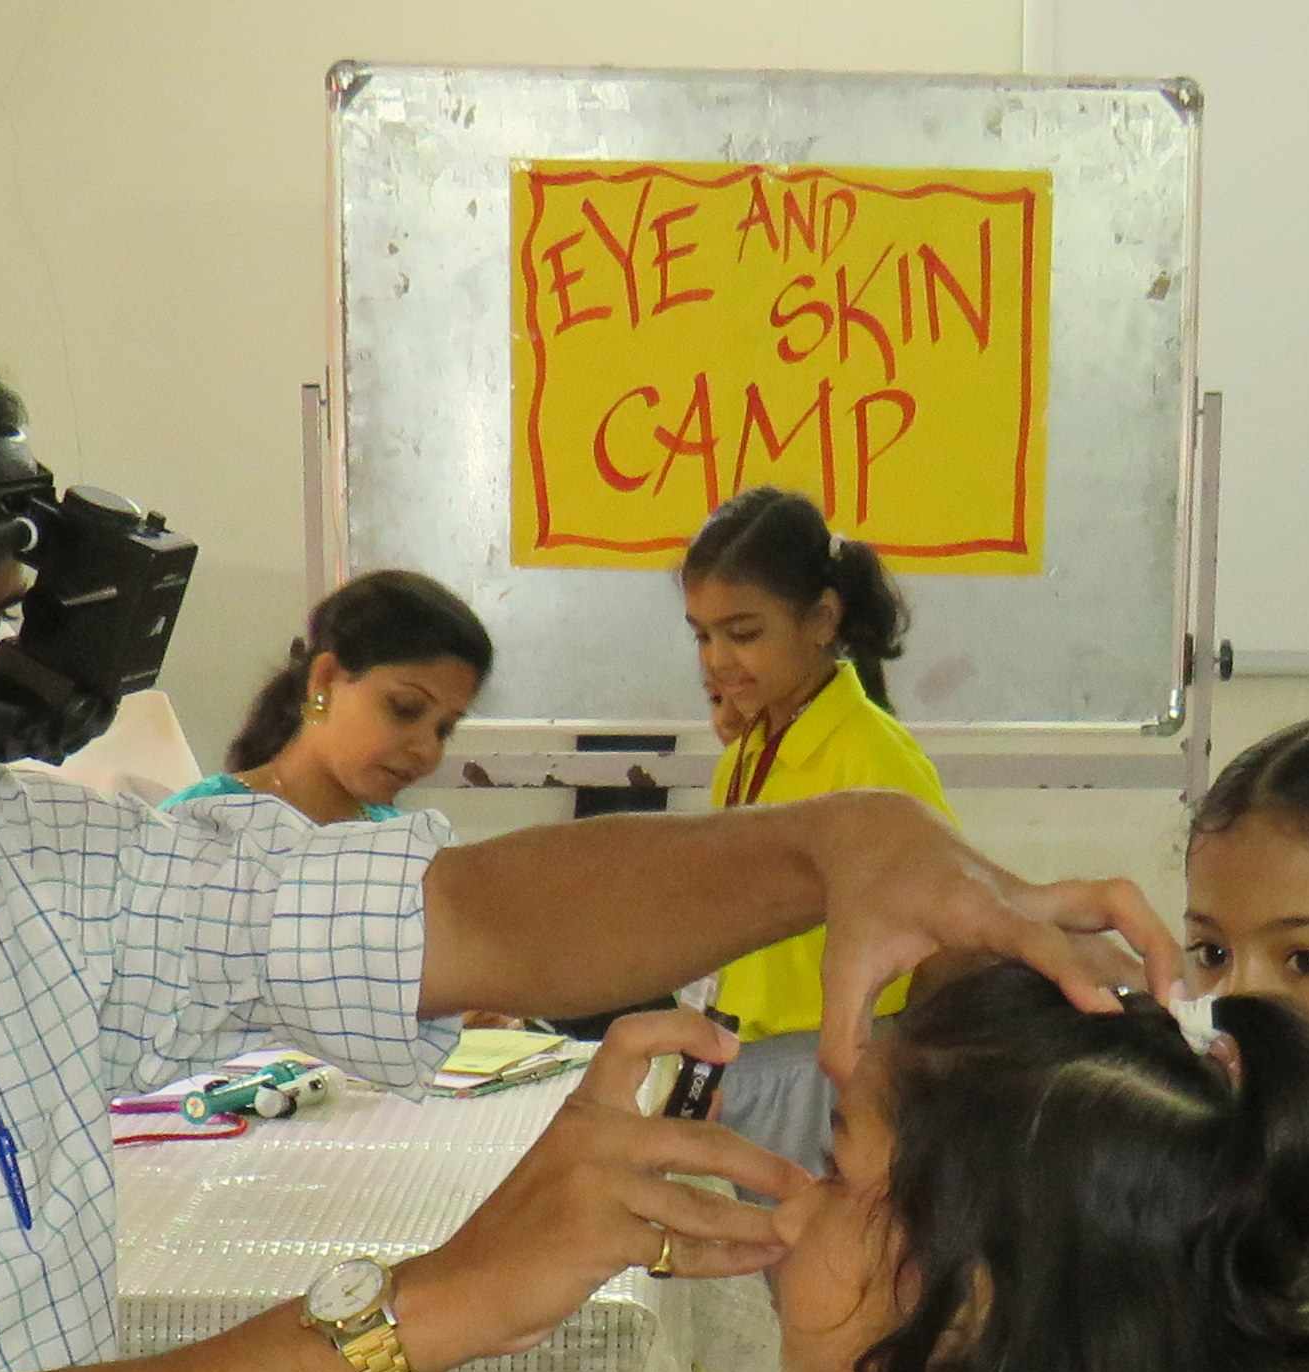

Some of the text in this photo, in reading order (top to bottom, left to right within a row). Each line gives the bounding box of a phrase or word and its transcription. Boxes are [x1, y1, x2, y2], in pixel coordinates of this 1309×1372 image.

[541, 175, 858, 336] EYE AND
[769, 217, 992, 385] SKIN
[592, 371, 917, 527] CAMP
